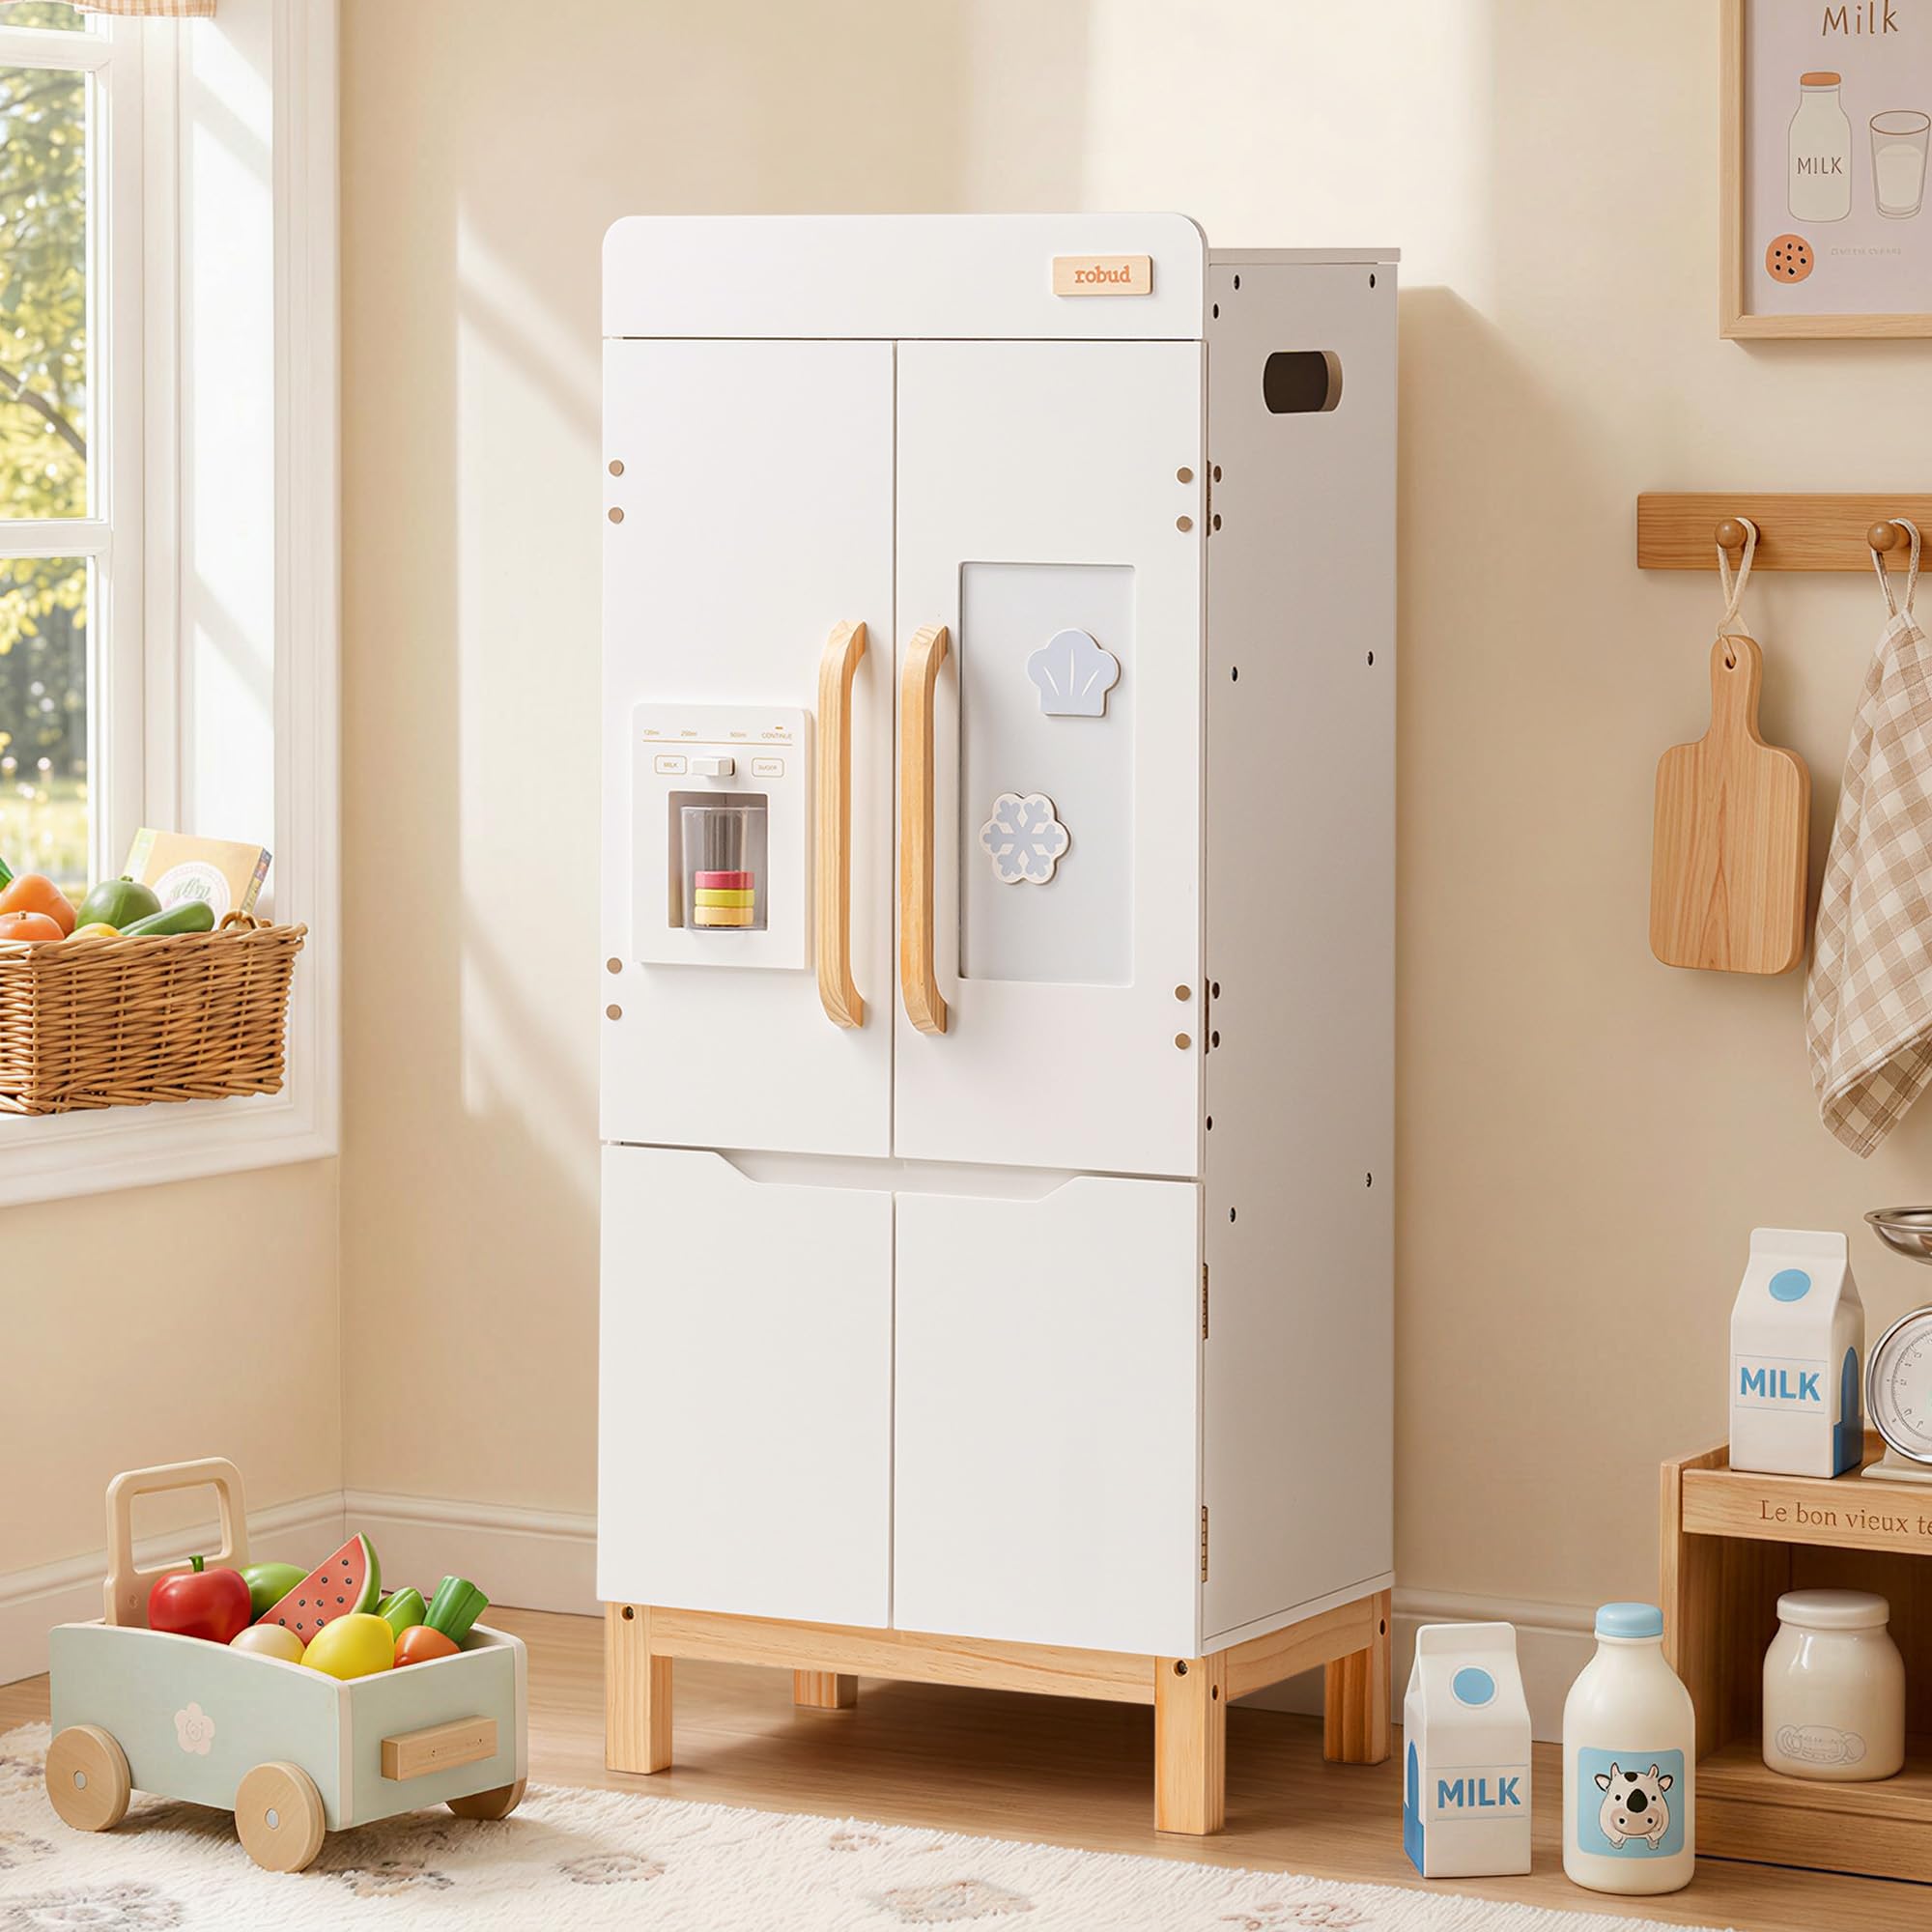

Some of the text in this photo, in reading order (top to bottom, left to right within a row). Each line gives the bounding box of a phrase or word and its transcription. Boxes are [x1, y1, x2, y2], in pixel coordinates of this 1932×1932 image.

[1822, 0, 1899, 36] Milk
[1797, 156, 1843, 175] MILK
[1074, 265, 1131, 283] robud
[1740, 1366, 1822, 1402] MILK
[1759, 1499, 1787, 1522] Le
[1795, 1501, 1837, 1526] bon
[1845, 1509, 1909, 1534] vieux
[1437, 1776, 1521, 1808] MILK
